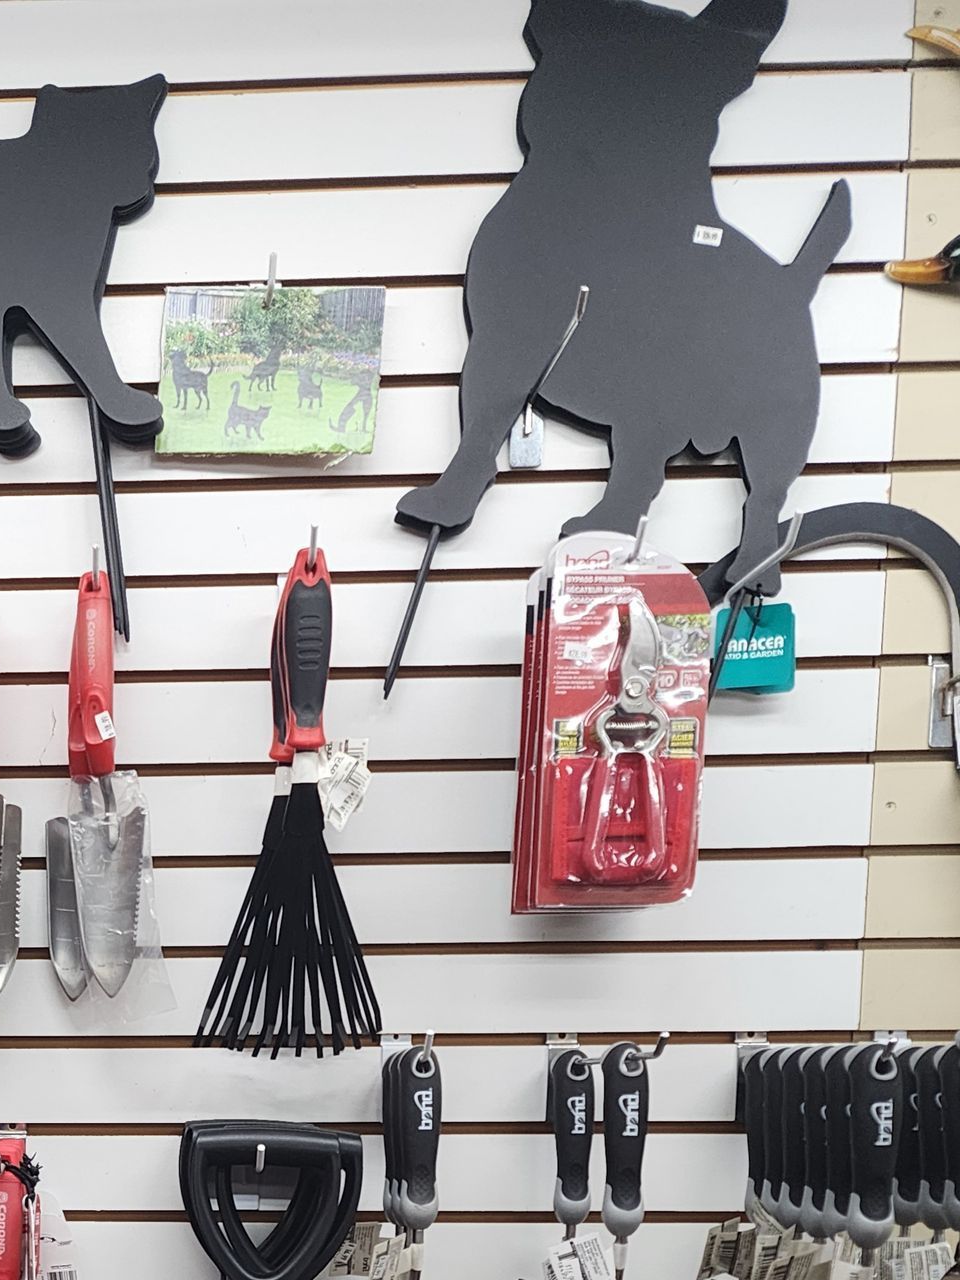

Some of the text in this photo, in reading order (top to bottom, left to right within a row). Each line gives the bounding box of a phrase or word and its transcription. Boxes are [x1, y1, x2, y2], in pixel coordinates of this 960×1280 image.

[86, 621, 97, 673] CORONA
[725, 652, 742, 660] ATIO
[749, 648, 784, 659] GARDEN
[727, 636, 784, 653] ANACEA
[414, 1088, 434, 1130] bond
[567, 1092, 586, 1135] bond
[618, 1091, 640, 1137] bond
[870, 1099, 893, 1147] bond
